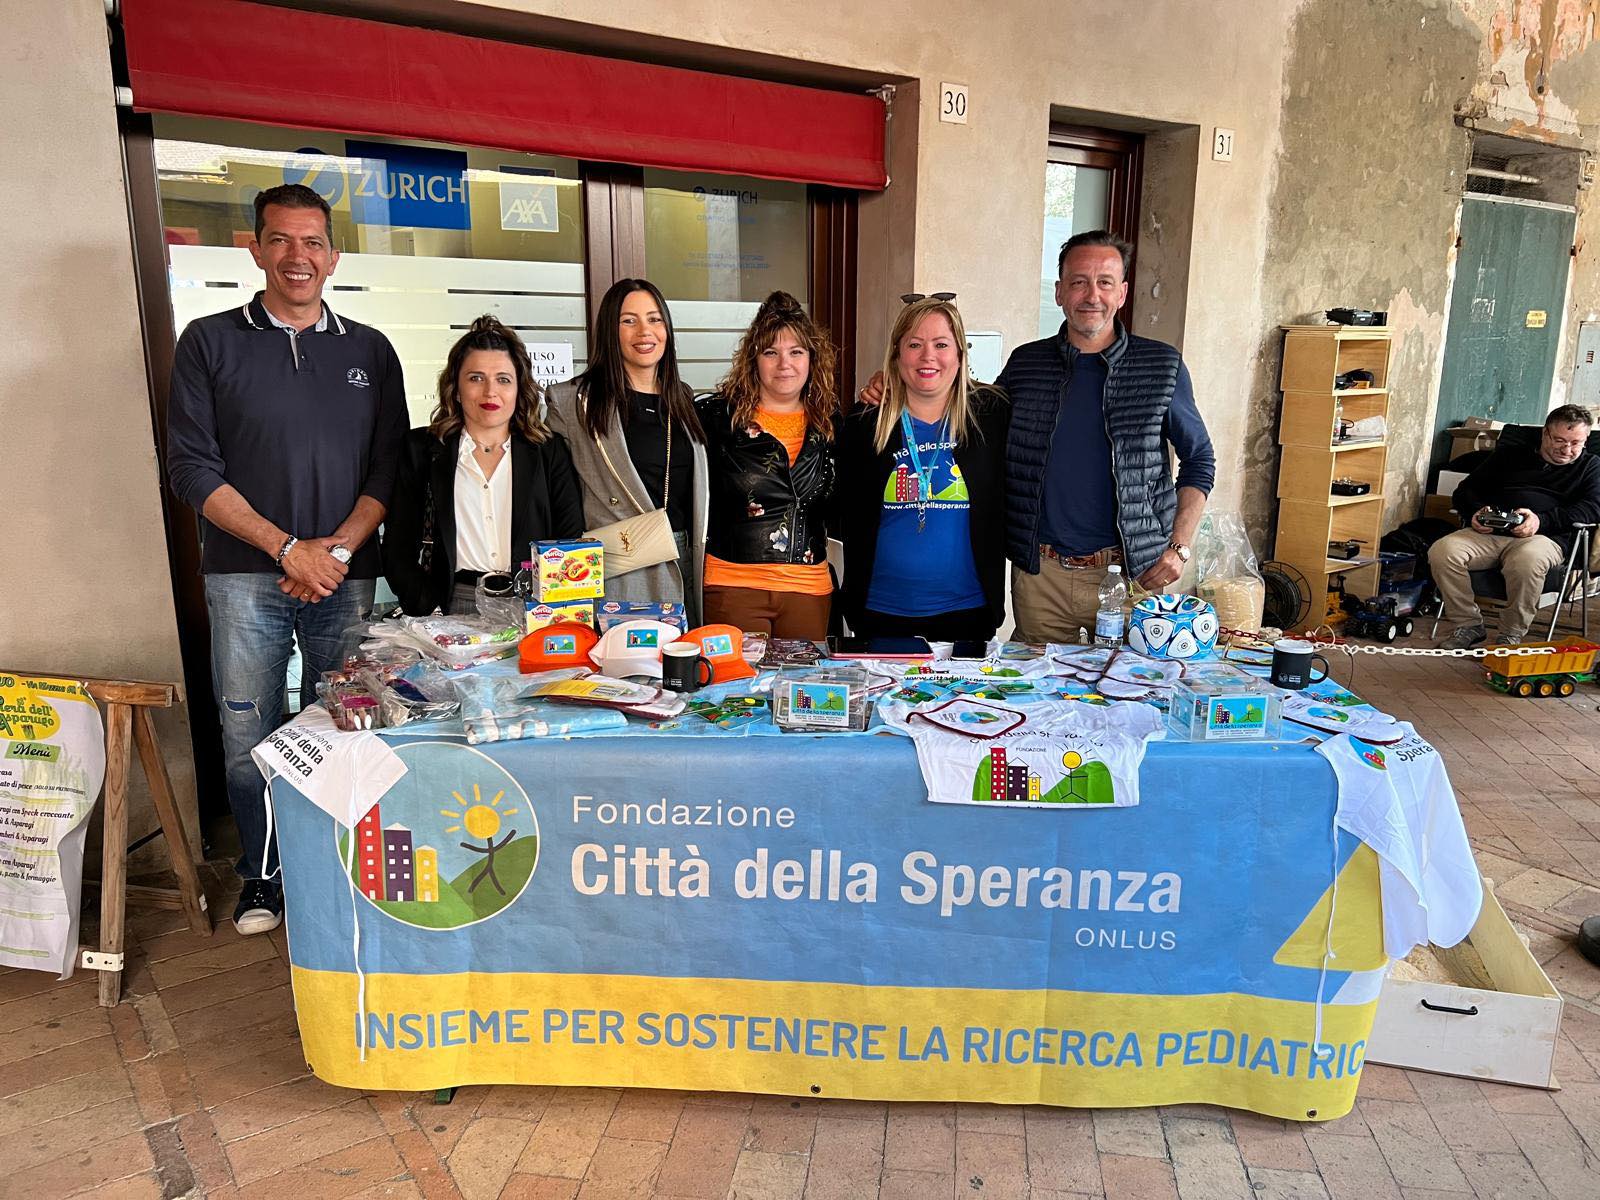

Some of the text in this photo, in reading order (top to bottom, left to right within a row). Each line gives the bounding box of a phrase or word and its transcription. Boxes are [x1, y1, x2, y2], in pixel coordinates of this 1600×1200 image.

[944, 91, 966, 116] 30
[1217, 134, 1231, 155] 31
[354, 170, 466, 203] ZURICH
[711, 189, 758, 204] ZURICH
[503, 199, 549, 224] AXA
[529, 352, 555, 361] IUSO
[544, 365, 558, 374] AL
[560, 365, 566, 374] 4
[939, 441, 957, 450] spe
[14, 741, 52, 758] Menù
[297, 739, 324, 765] della
[1396, 745, 1433, 762] Spera
[18, 783, 33, 791] pesce
[21, 808, 39, 817] Speck
[40, 811, 75, 819] croccante
[572, 795, 796, 828] Fondazione
[11, 819, 35, 829] Asparagi
[21, 833, 48, 845] Asparagi
[12, 859, 36, 870] Asparagi
[26, 873, 57, 883] formaggio
[571, 843, 1182, 917] Città della Speranza
[1075, 927, 1177, 950] ONLUS
[355, 1009, 530, 1050] INSIEME
[543, 1008, 625, 1044] PER
[636, 1012, 886, 1060] SOSTENERE
[898, 1025, 950, 1062] LA
[963, 1026, 1143, 1068] RICERCA
